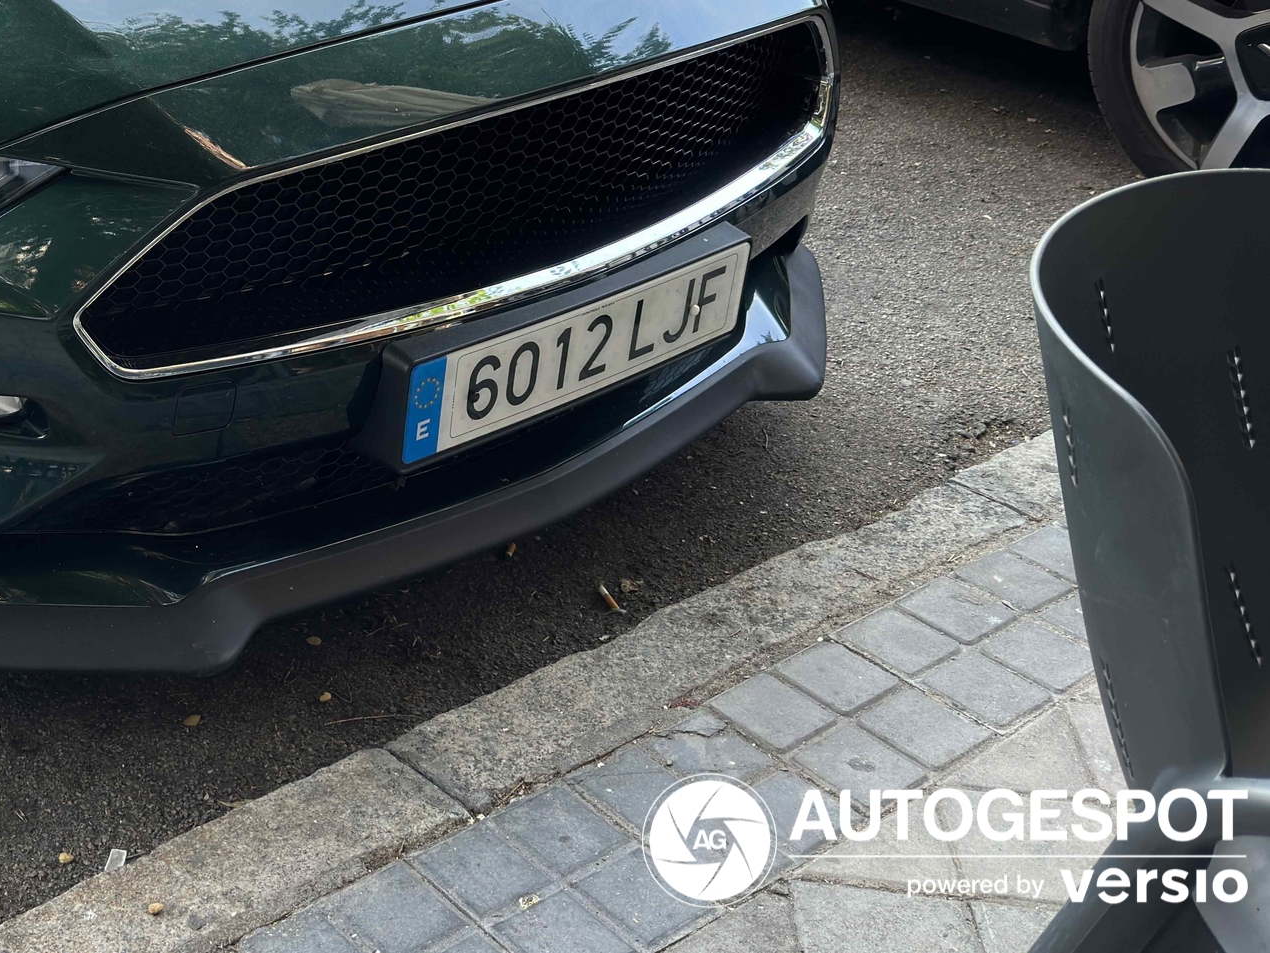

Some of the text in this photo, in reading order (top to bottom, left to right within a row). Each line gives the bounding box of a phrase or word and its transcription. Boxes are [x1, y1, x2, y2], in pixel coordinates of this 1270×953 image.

[466, 265, 727, 421] 6012 LJF
[416, 418, 431, 441] E
